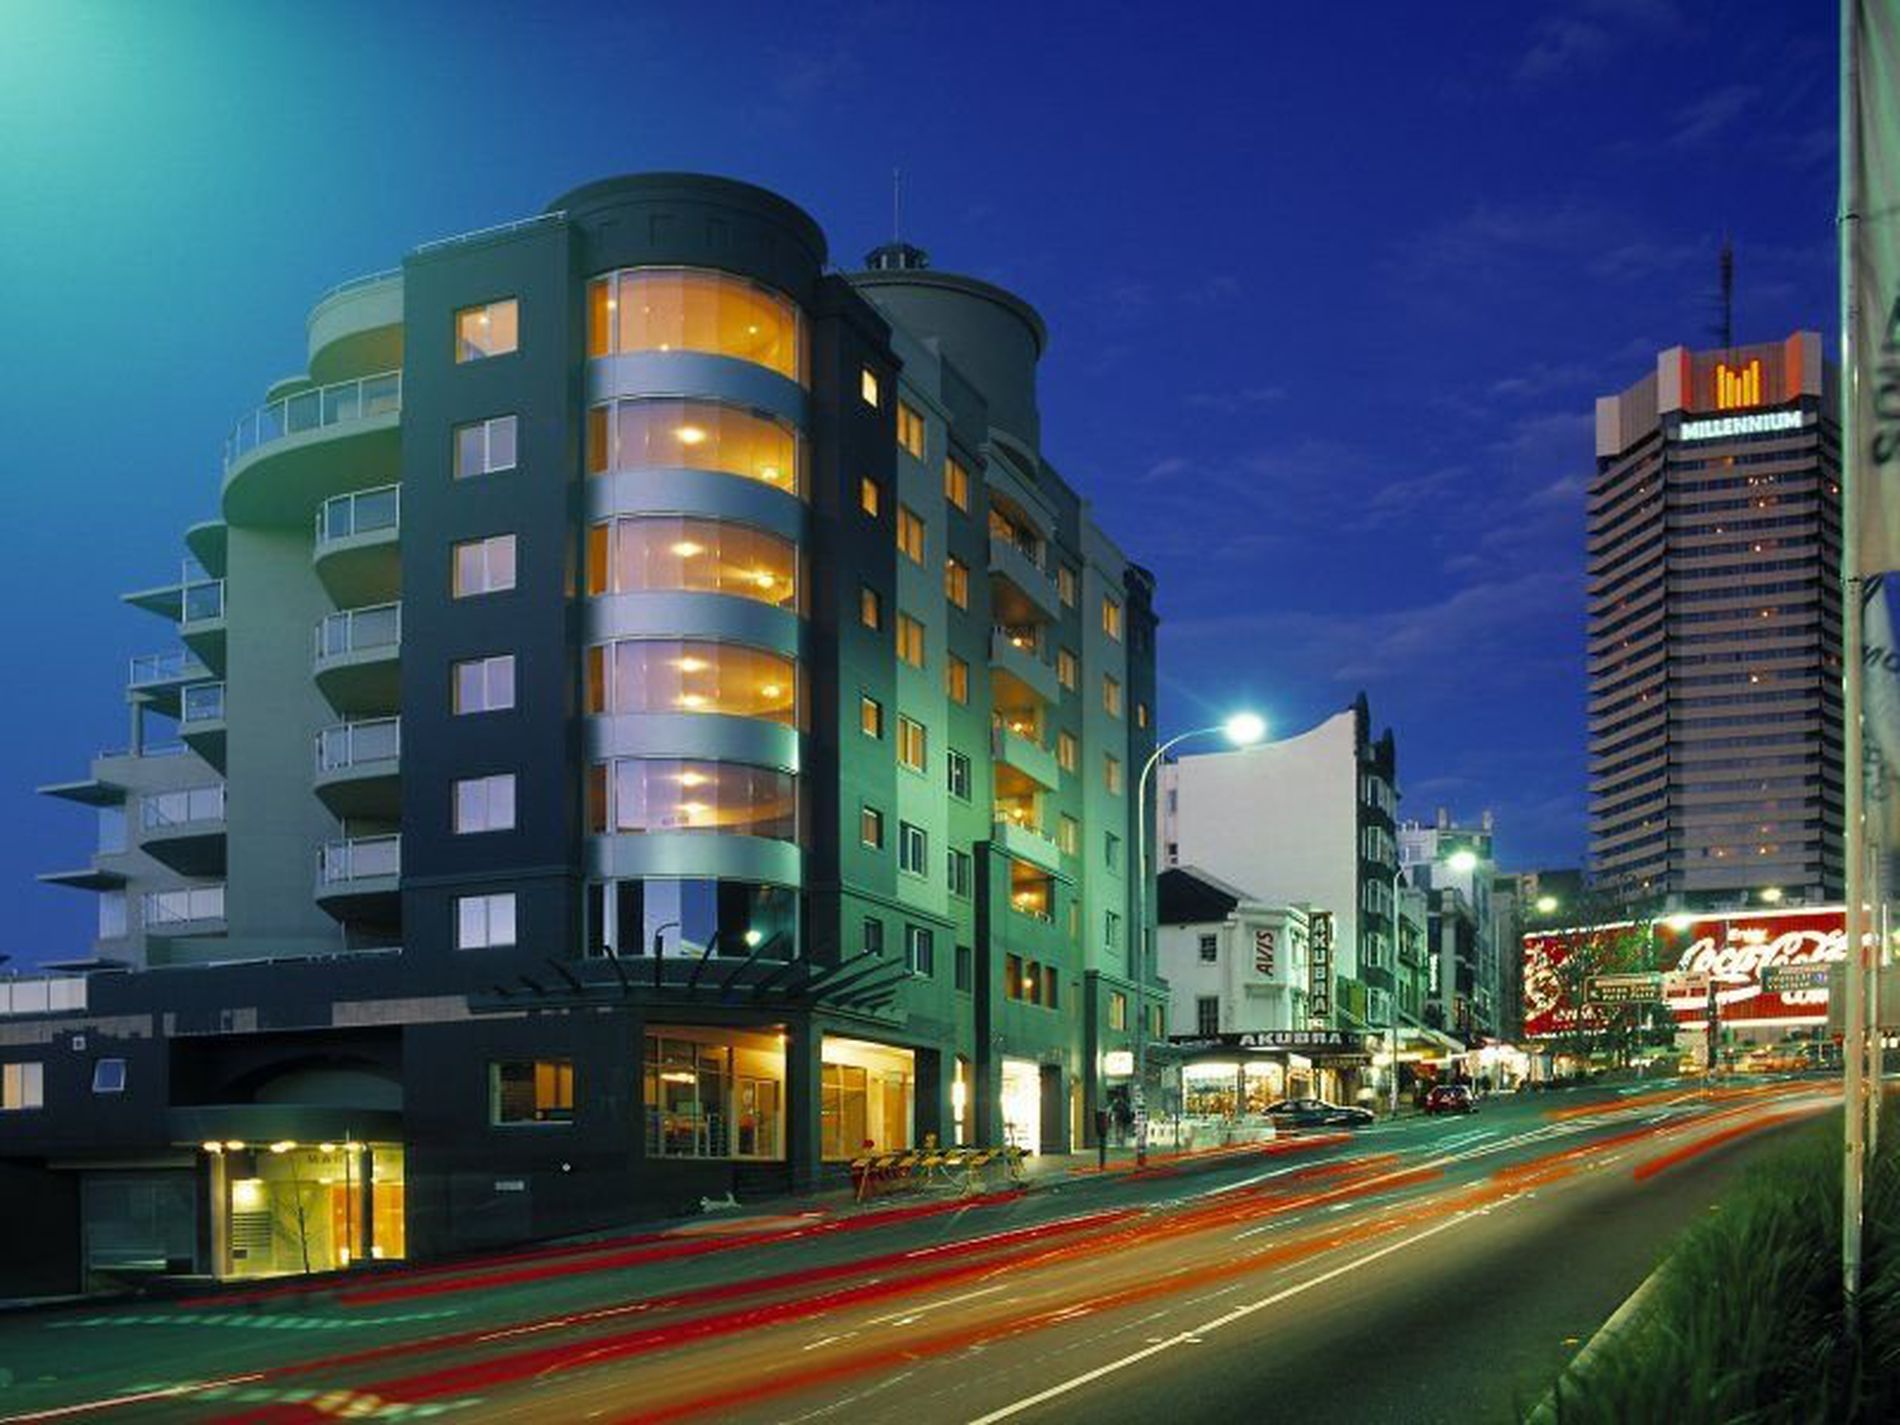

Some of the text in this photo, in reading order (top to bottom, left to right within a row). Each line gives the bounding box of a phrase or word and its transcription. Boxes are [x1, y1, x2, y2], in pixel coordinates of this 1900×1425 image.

[1681, 410, 1802, 441] MILLENNIUM
[1256, 930, 1274, 977] AVIS
[1314, 916, 1328, 1015] AKUBRA
[1239, 1032, 1342, 1046] AKUBRA
